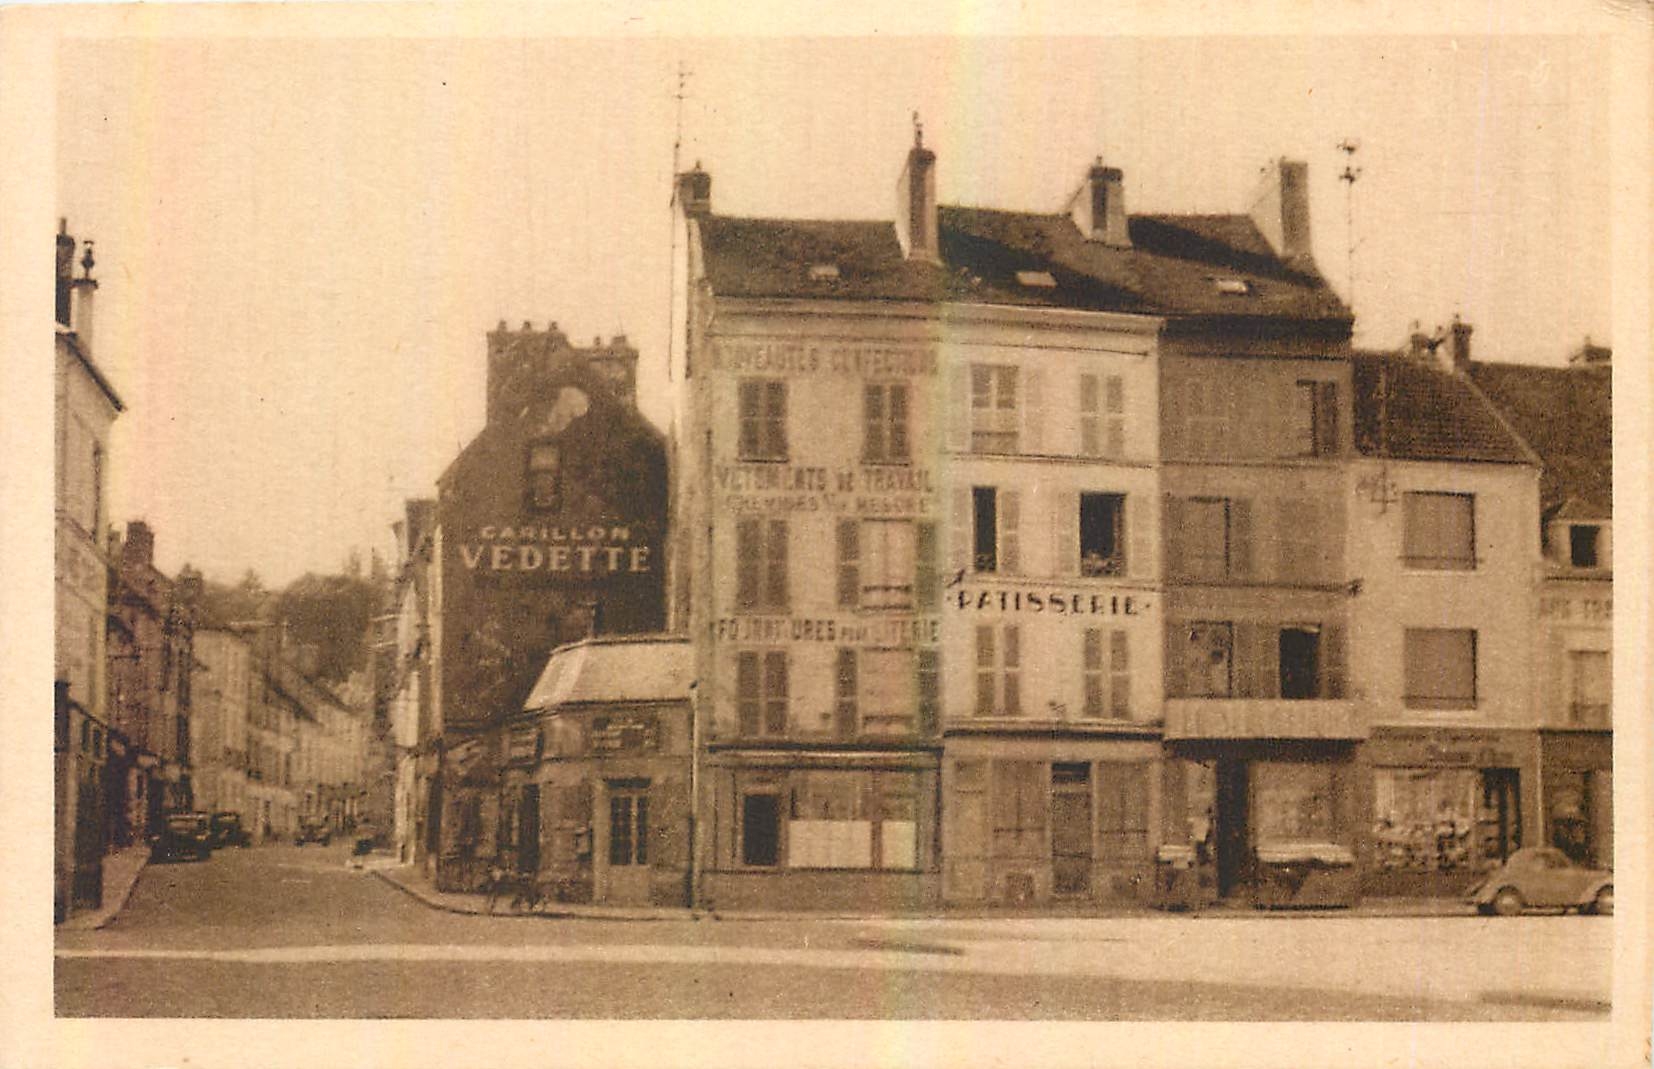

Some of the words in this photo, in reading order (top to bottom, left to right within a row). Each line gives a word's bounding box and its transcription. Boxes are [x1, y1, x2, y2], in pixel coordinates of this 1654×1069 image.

[864, 468, 932, 493] TRAVAIL
[479, 526, 630, 541] CARILLON
[459, 545, 651, 571] VEDETTE
[958, 590, 1137, 615] PATISSERIE
